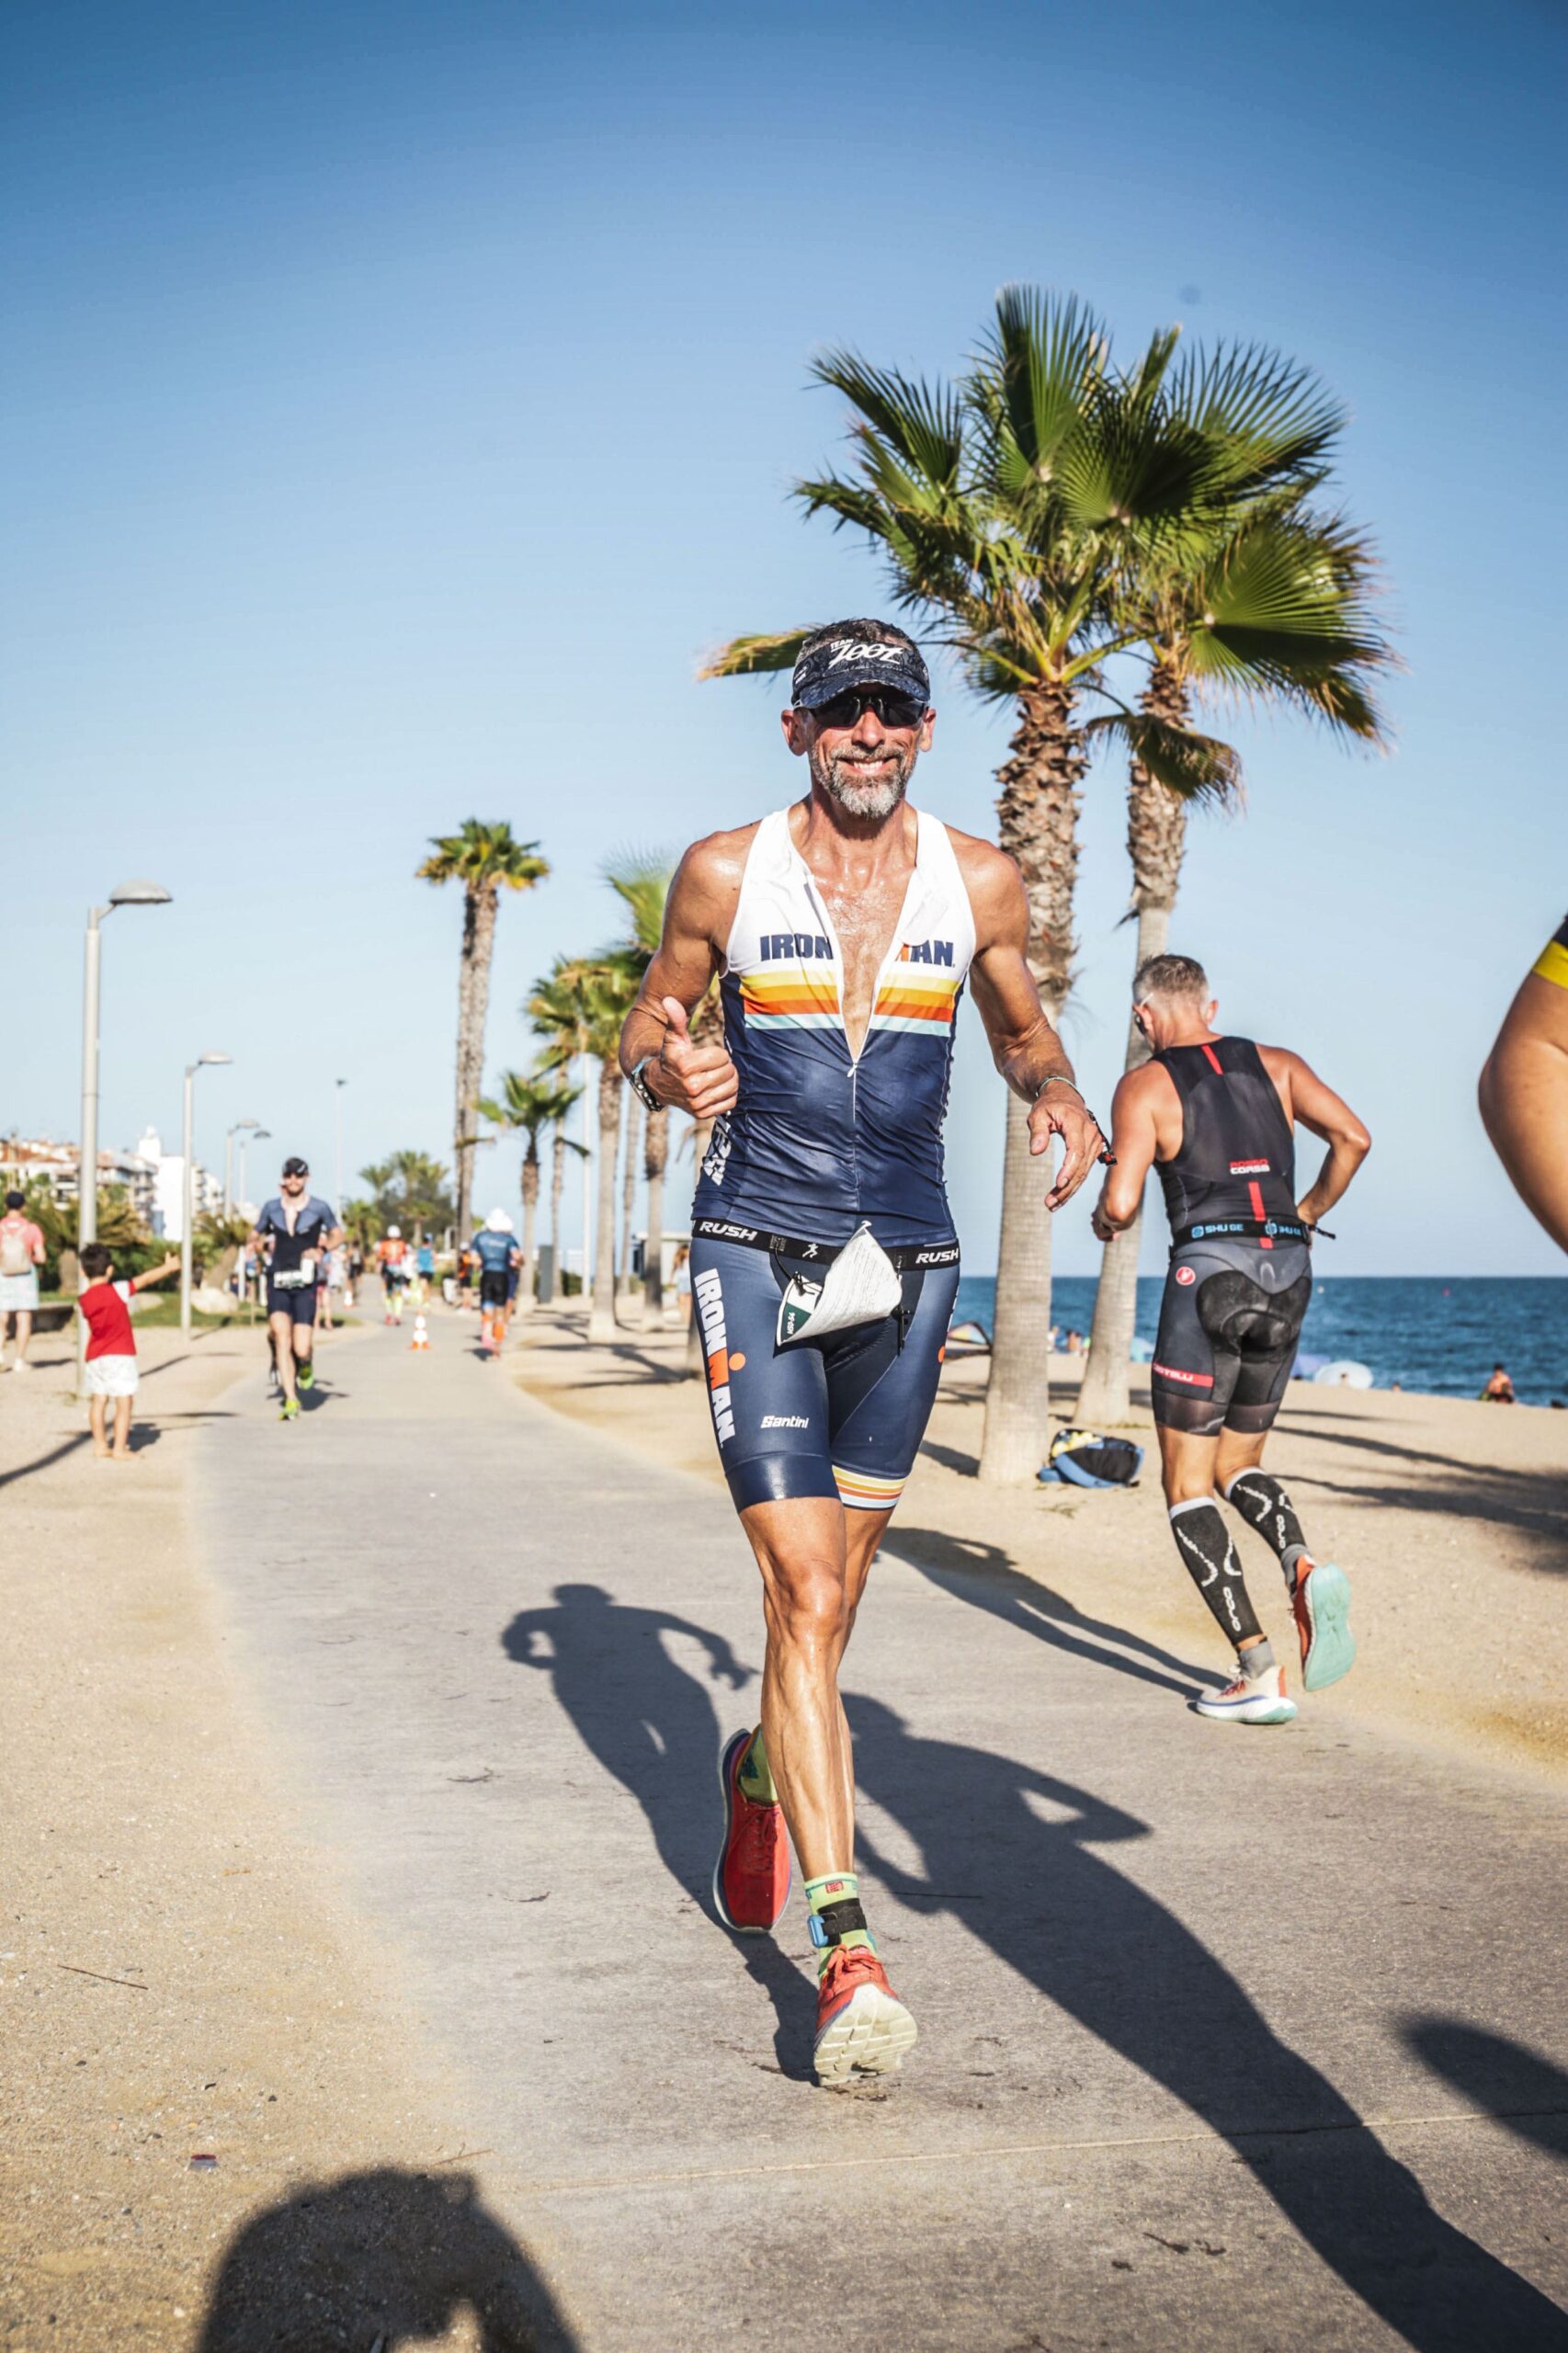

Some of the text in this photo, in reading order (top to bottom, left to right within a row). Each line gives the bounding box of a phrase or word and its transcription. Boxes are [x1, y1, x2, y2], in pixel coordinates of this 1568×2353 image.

[760, 933, 834, 961] IRON
[699, 1221, 758, 1242] RUSH
[915, 1248, 959, 1264] RUSH
[694, 1267, 735, 1446] IRONMAN
[760, 1415, 810, 1428] Santini
